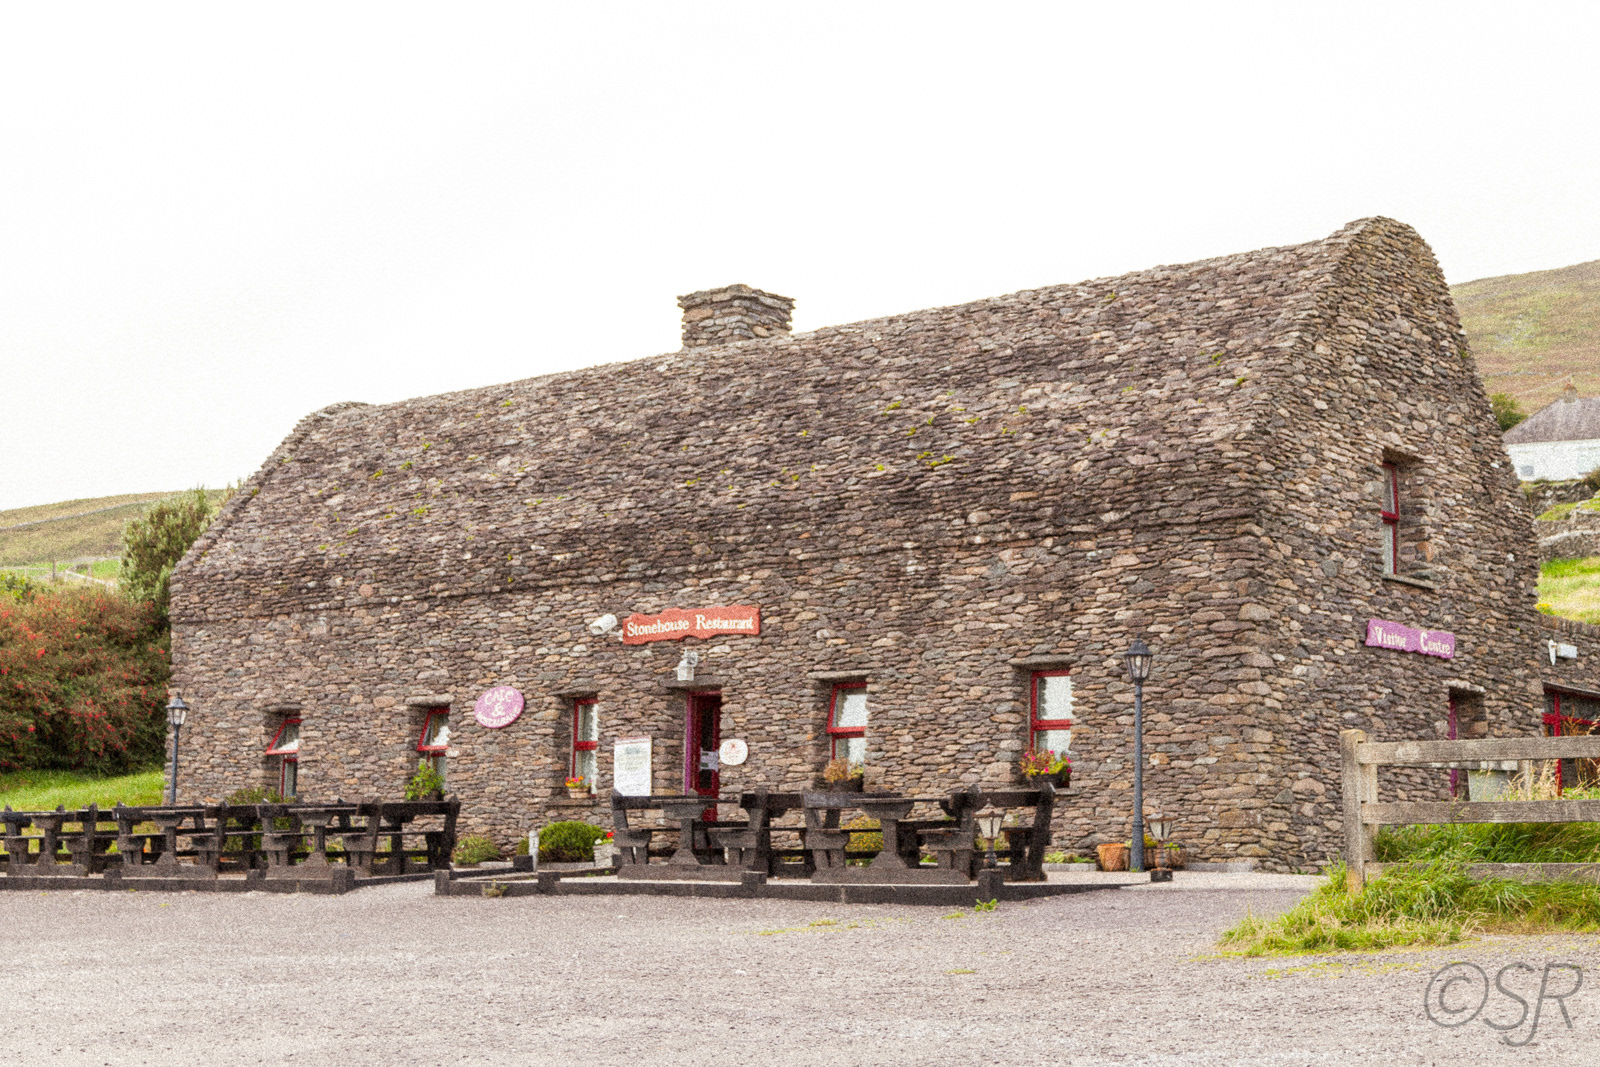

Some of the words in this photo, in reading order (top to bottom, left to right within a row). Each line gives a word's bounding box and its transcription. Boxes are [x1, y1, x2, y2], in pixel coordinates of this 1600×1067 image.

[627, 619, 690, 637] Stonehouse
[695, 614, 754, 630] Restaurant
[1374, 626, 1407, 648] Visitor
[1420, 631, 1451, 655] Centre
